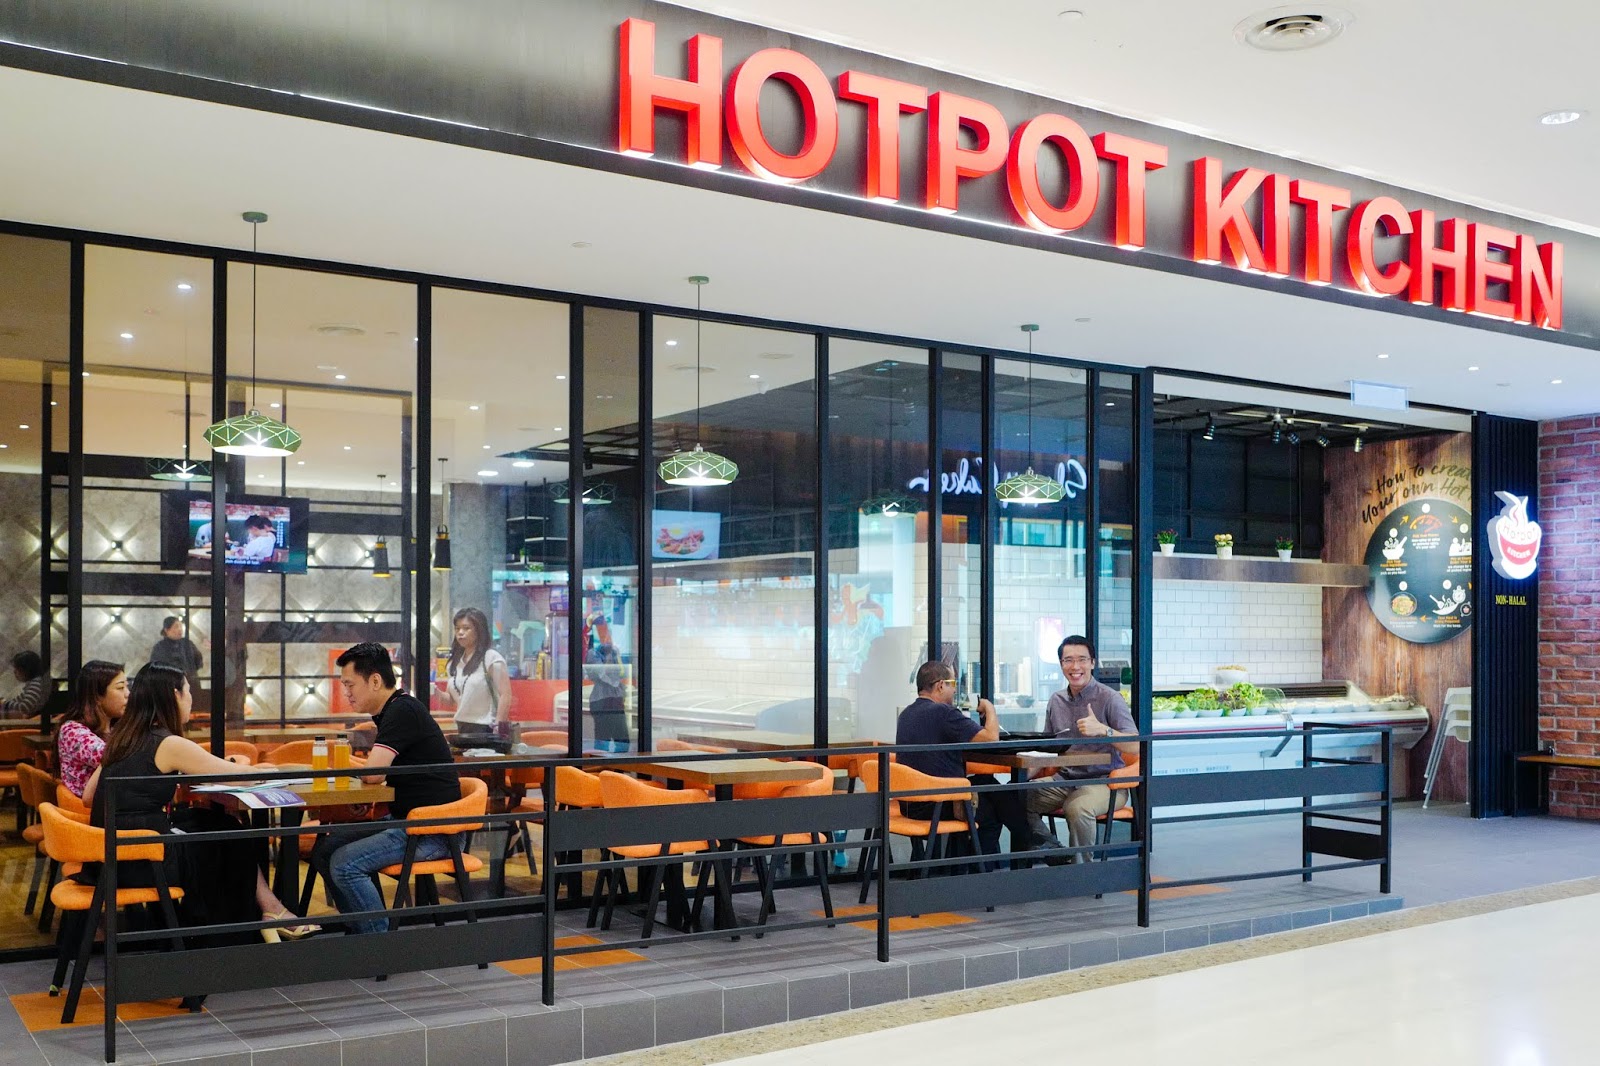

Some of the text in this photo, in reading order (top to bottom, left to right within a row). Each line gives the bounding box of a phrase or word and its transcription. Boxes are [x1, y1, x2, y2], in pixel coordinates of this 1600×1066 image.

[618, 16, 1564, 331] HOTPOT KITCHEN
[1376, 462, 1472, 494] How to creat
[1402, 481, 1435, 499] own
[1495, 594, 1527, 606] NON-HALAL
